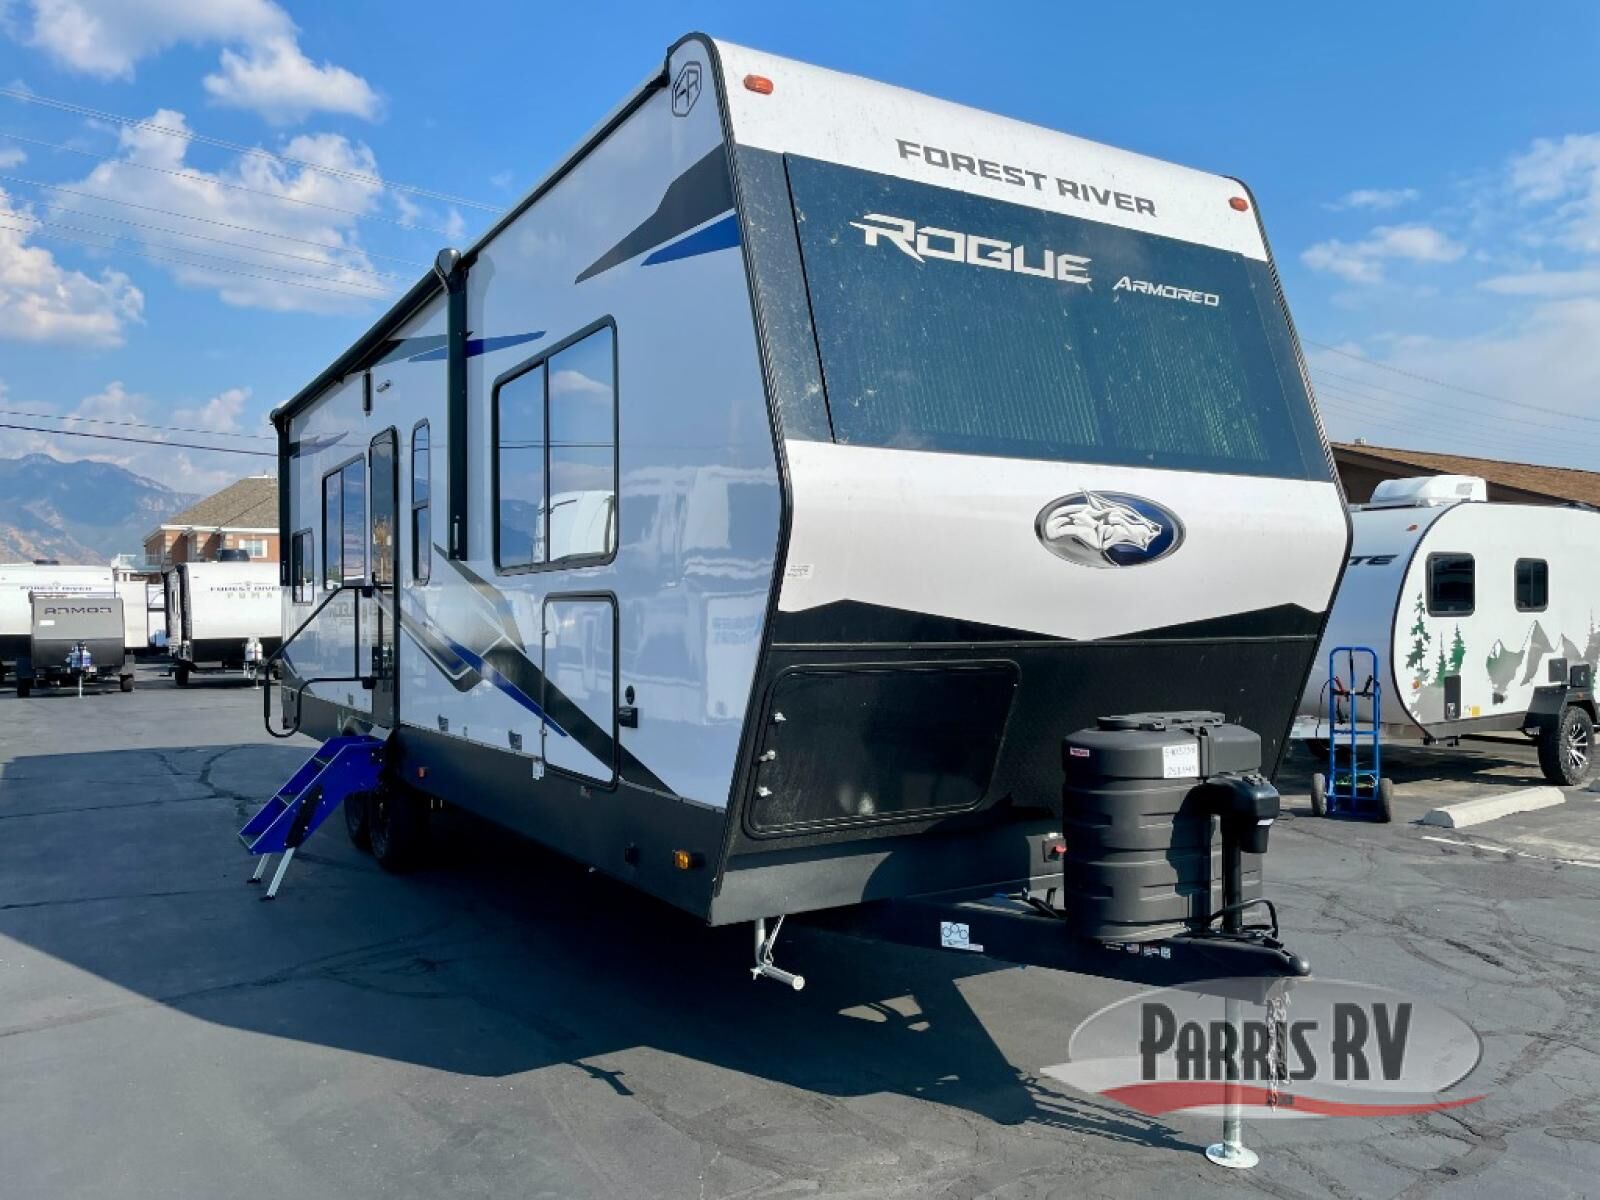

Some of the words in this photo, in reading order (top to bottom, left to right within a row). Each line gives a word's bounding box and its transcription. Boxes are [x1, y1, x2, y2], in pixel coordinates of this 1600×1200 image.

[896, 139, 1047, 190] FOREST
[1056, 177, 1157, 217] RIVER
[850, 213, 1092, 284] ROGUE
[1113, 276, 1220, 306] ARMORED
